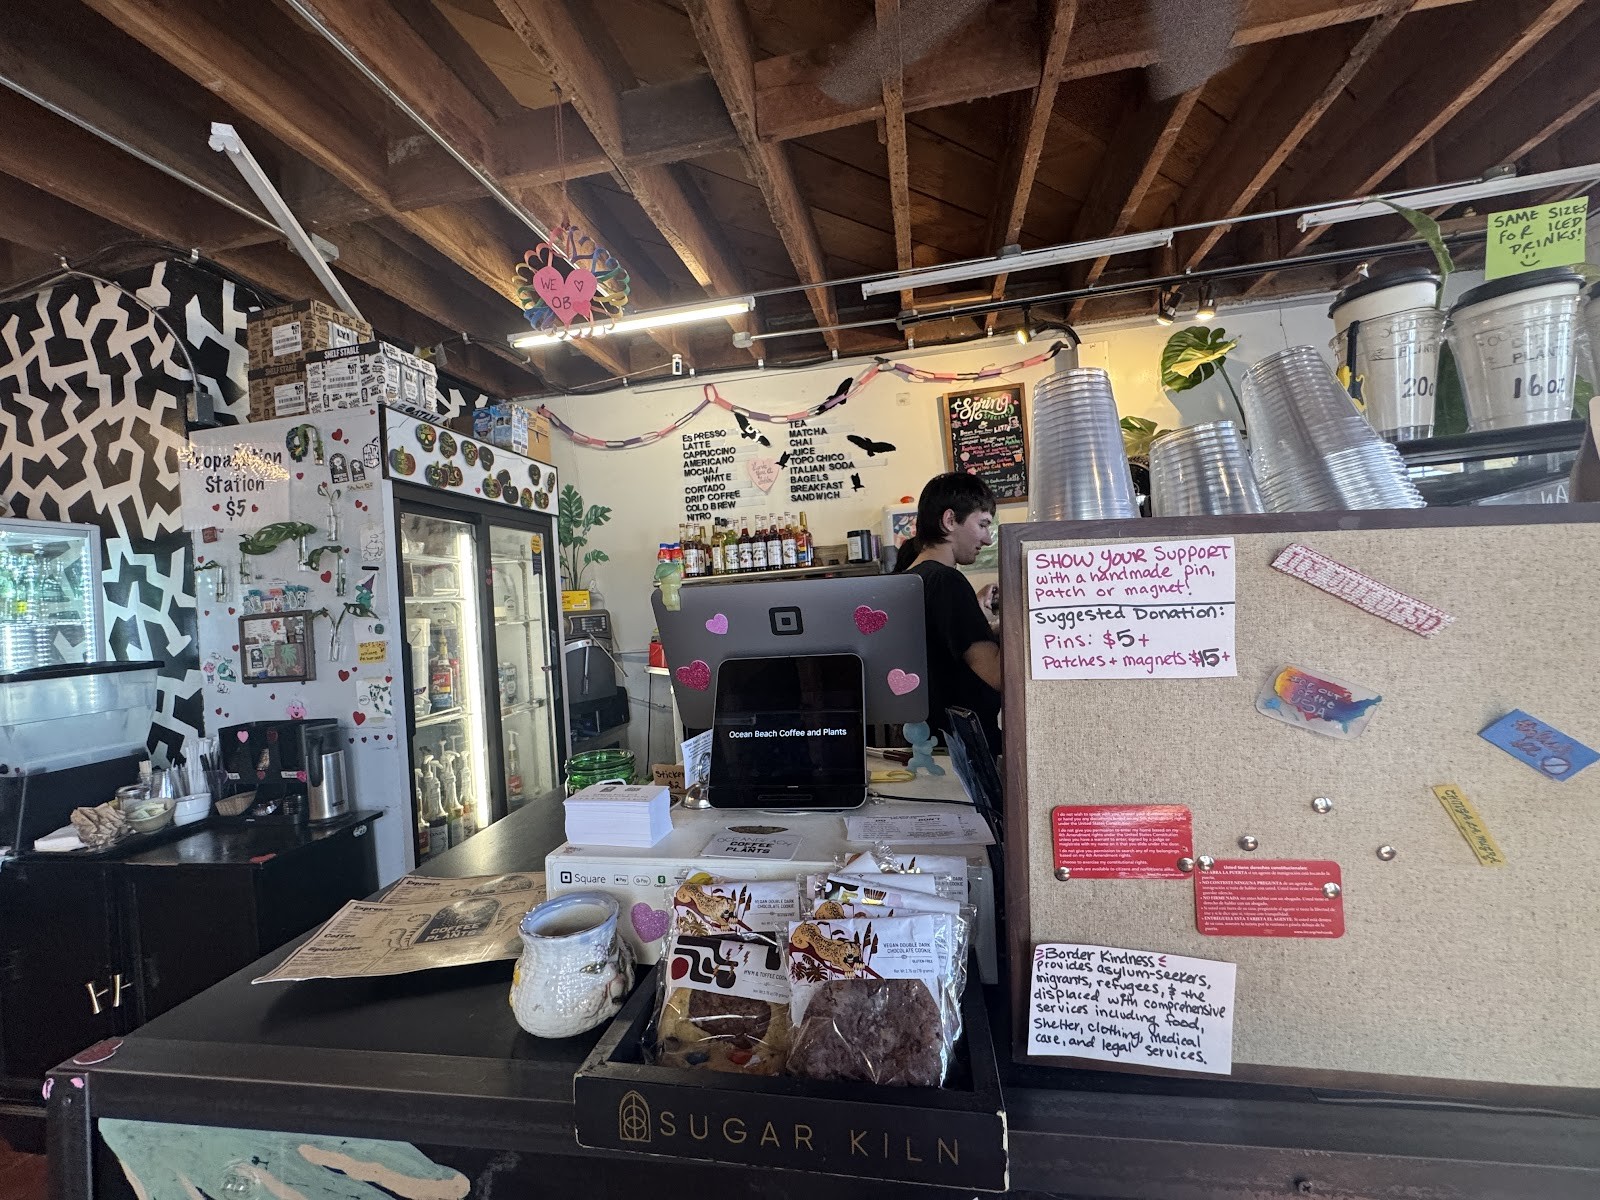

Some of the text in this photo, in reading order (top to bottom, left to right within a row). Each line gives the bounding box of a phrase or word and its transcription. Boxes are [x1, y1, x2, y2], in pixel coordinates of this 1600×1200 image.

[1494, 204, 1587, 228] SAME SIZES
[1549, 217, 1582, 231] ICED
[1509, 228, 1582, 255] DRINKS!
[540, 277, 557, 291] WE
[551, 296, 572, 310] OB
[325, 345, 360, 359] SHELF STABLE
[955, 396, 1009, 422] Spring
[789, 419, 807, 429] TEA
[789, 427, 828, 438] MATCHA
[682, 441, 711, 451] LATTE
[789, 438, 813, 447] CHAI
[683, 447, 736, 459] CAPPUCCINO
[790, 447, 816, 456] JUICE
[683, 455, 735, 468] AMERICANO
[790, 453, 845, 465] TOPO CHICO
[684, 466, 719, 477] MOCHA/
[790, 461, 855, 475] ITALIAN SODA
[205, 474, 265, 493] Station
[703, 473, 732, 483] WHITE
[790, 473, 829, 484] BAGELS
[685, 483, 726, 494] CORTADO
[790, 481, 844, 493] BREAKFAST
[685, 490, 740, 504] DRIP COFFEE
[790, 491, 840, 502] SANDWICH
[226, 496, 246, 521] $5
[686, 500, 736, 512] COLD BREW
[687, 512, 712, 521] NITRO
[1035, 553, 1095, 569] SHOW
[1098, 548, 1147, 573] YOUR
[1036, 563, 1216, 585] with a handmade pin,
[1035, 579, 1193, 602] patch or magnet!
[1035, 604, 1226, 630] Suggested Donation:
[1044, 633, 1093, 650] Pins:
[1042, 654, 1106, 670] Patches
[1313, 694, 1335, 709] the
[1317, 688, 1344, 701] OUT
[728, 727, 847, 739] Ocean Beach Coffee and Plants
[725, 846, 771, 854] PLANTS
[574, 873, 607, 885] Square
[430, 922, 482, 935] COFFEE
[424, 930, 477, 942] PLANTS
[1044, 947, 1156, 969] Border Kindness
[1036, 959, 1094, 973] provides
[759, 972, 775, 980] TOFFEE
[1036, 973, 1093, 990] migrants,
[1096, 978, 1165, 998] refugees,
[1180, 989, 1206, 1002] the
[1033, 988, 1226, 1019] displaced with comprehensive
[1035, 1002, 1205, 1034] services including food,
[1087, 1023, 1144, 1049] clothing,
[1035, 1033, 1208, 1065] care, and legal services.
[659, 1110, 960, 1166] SUGAR KILN
